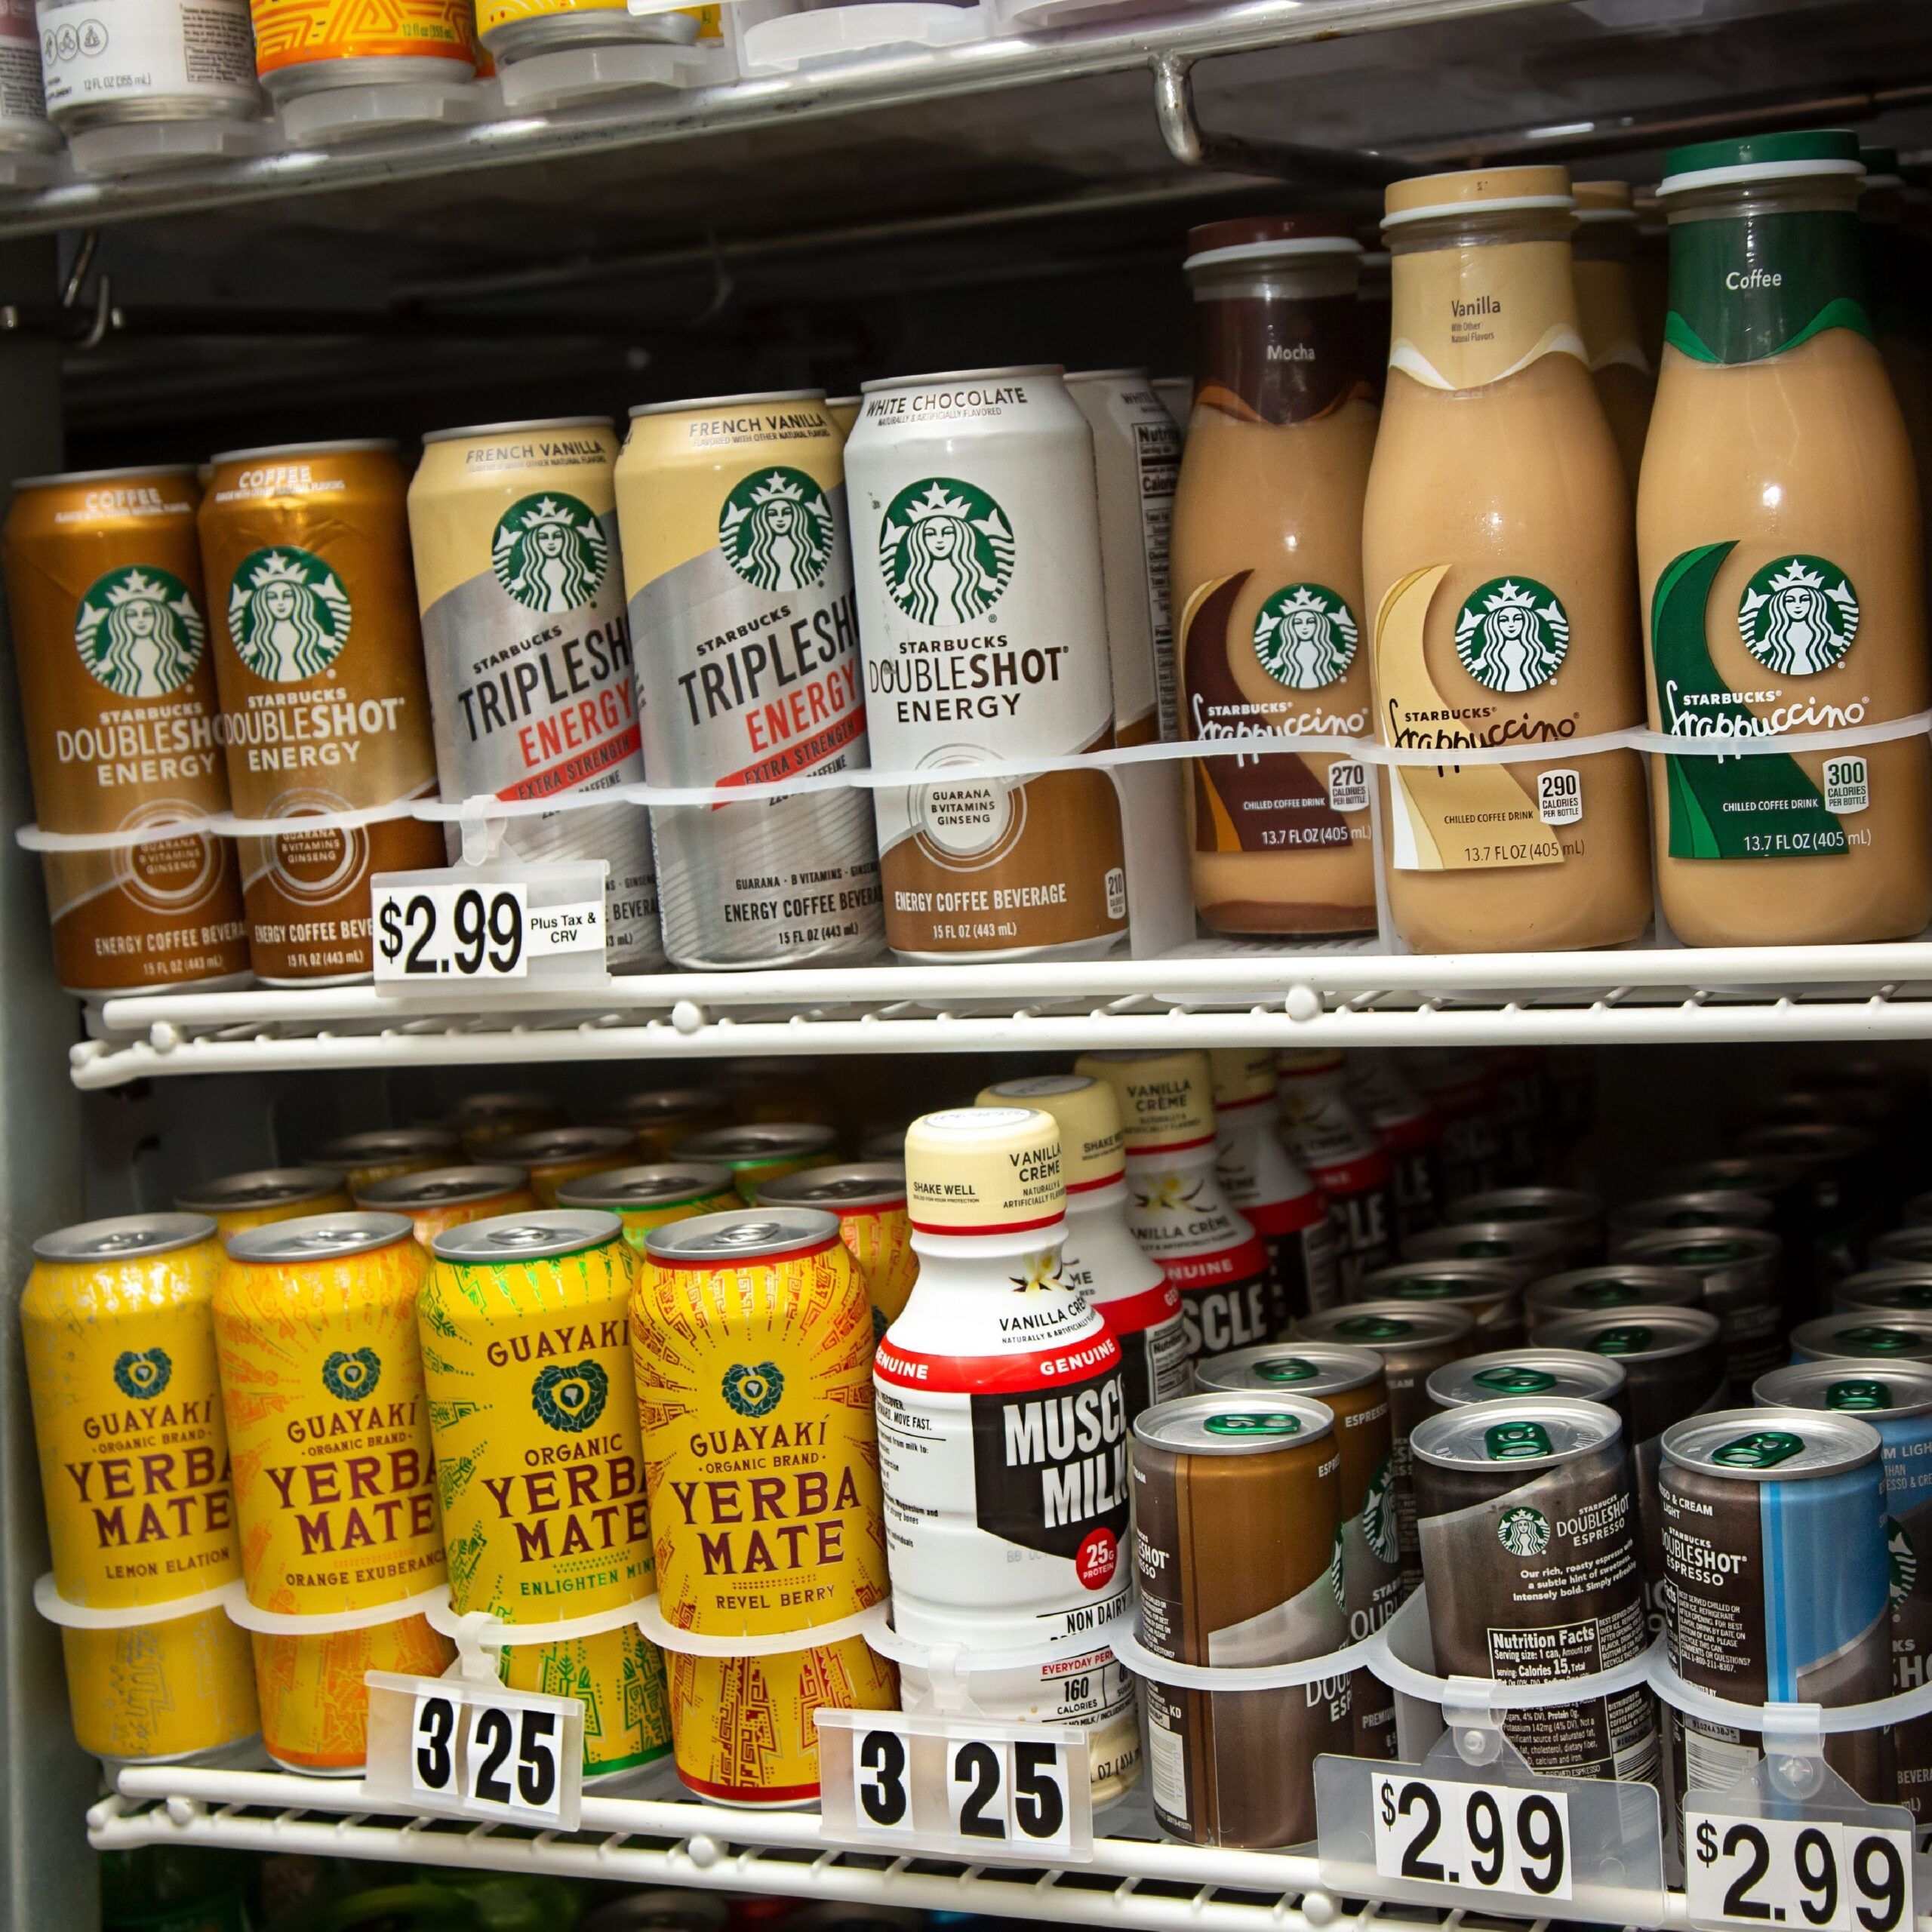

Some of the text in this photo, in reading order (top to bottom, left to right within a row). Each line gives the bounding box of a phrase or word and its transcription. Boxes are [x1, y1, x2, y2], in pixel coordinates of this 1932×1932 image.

[1726, 269, 1782, 291] Coffee
[1452, 296, 1500, 317] Vanilla
[1463, 321, 1480, 331] Other
[1472, 331, 1494, 341] Flavors
[1266, 343, 1315, 361] Mocha
[866, 387, 1027, 417] WHITE CHOCOLATE
[690, 413, 827, 437] FRENCH VANILLA
[915, 406, 1001, 422] ARTIFICIALLY FLAVORED
[465, 440, 603, 464] FRENCH VANILLA
[238, 465, 312, 488] COFFEE
[85, 488, 162, 509] COFFEE
[697, 605, 791, 657] STARBUCKS
[473, 626, 562, 674] STARBUCKS
[899, 635, 1008, 654] STARBUCKS
[678, 589, 862, 726] TRIPLESH
[457, 614, 633, 742] TRIPLESH
[869, 646, 1063, 694] DOUBLESHOT
[248, 688, 346, 708] STARBUCKS
[746, 660, 857, 752] ENERGY
[897, 693, 1021, 723] ENERGY
[1683, 691, 1776, 706] STARBUCKS
[100, 703, 202, 724] STARBUCKS
[1208, 703, 1287, 716] STARBUCKS
[1404, 707, 1492, 722] STARBUCKS
[225, 698, 398, 745] DOUBLESHOT
[517, 677, 633, 768] ENERGY
[57, 714, 225, 761] DOUBLESHO
[794, 720, 855, 763] STRENGTH
[248, 741, 360, 771] ENERGY
[98, 753, 217, 786] ENERGY
[518, 736, 630, 801] EXTRA STRENGTH
[1332, 765, 1364, 786] 270
[1829, 761, 1864, 786] 300
[932, 789, 991, 801] GUARANA
[1333, 787, 1366, 798] CALORIES
[1543, 775, 1577, 798] 290
[1828, 786, 1866, 798] CALORIES
[940, 801, 995, 812] VITAMINS
[1543, 798, 1578, 810] CALORIES
[1723, 798, 1818, 812] CHILLED COFFEE DRINK
[1829, 795, 1866, 807] PER BOTTLE
[938, 814, 990, 825] GINSENG
[1444, 810, 1534, 824] CHILLED COFFEE DRINK
[1543, 808, 1578, 817] PER BOTTLE
[291, 838, 340, 852] VITAMINS
[1464, 839, 1584, 862] 13.7 FL OZ (405 mL)
[1743, 829, 1871, 851] 13.7 FL OZ (405 mL)
[288, 851, 336, 863] GINSENG
[736, 869, 842, 891] GUARANA VITAMINS
[724, 894, 835, 923] ENERGY COFFEE
[895, 884, 1066, 912] ENERGY COFFEE BEVERAGE
[255, 920, 336, 943] ENERGY COFFEE
[379, 888, 522, 975] $2.99
[531, 912, 583, 930] Plus Tax
[973, 922, 1017, 939] (443 mL)
[95, 929, 198, 956] ENERGY COFFEE
[550, 929, 577, 945] CRV
[1127, 1080, 1192, 1099] VANILLA
[1010, 1143, 1061, 1167] VANILLA
[1019, 1158, 1060, 1183] CRÈME
[913, 1181, 975, 1195] SHAKE WELL
[1023, 1184, 1057, 1196] NATURALLY
[1003, 1195, 1048, 1208] ARTIFICIALLY
[999, 1309, 1066, 1331] VANILLA
[1002, 1333, 1045, 1344] NATURALLY
[1040, 1338, 1115, 1376] GENUINE
[84, 1392, 215, 1441] GUAYAKÍ
[287, 1393, 421, 1444] GUAYAKÍ
[912, 1417, 932, 1431] FAST.
[1003, 1373, 1127, 1466] MUSC
[162, 1429, 205, 1445] BRAND
[307, 1432, 407, 1457] ORGANIC BRAND
[690, 1414, 831, 1458] GUAYAKÍ
[525, 1435, 623, 1466] ORGANIC
[706, 1453, 820, 1475] ORGANIC BRAND
[670, 1465, 862, 1527] YERBA
[1579, 1494, 1617, 1515] STARBUCKS
[92, 1488, 230, 1549] MATE
[1556, 1492, 1629, 1538] DOUBLESHOT
[1663, 1506, 1681, 1520] LIGHT
[1678, 1499, 1713, 1516] CREAM
[294, 1494, 435, 1555] MATE
[513, 1500, 650, 1563] MATE
[1573, 1518, 1625, 1547] ESPRESSO
[697, 1518, 846, 1577] MATE
[1669, 1527, 1712, 1549] STARBUCKS
[106, 1546, 230, 1580] LEMON ELATION
[1083, 1562, 1114, 1580] PROTEIN
[1521, 1549, 1623, 1580] Our rich, roasty espresso
[1666, 1554, 1724, 1586] ESPRESSO
[286, 1571, 349, 1587] ORANGE
[521, 1571, 619, 1597] ENLIGHTEN
[1513, 1577, 1611, 1602] Intensely bold. Simply
[1537, 1574, 1587, 1589] subtle hint
[716, 1584, 835, 1611] REVEL BERRY
[1707, 1599, 1730, 1612] CHILLED
[1066, 1596, 1127, 1634] NON DAIRY
[1493, 1626, 1595, 1650] Nutrition Facts
[1727, 1623, 1743, 1631] BEST
[1717, 1638, 1738, 1647] PLEASE
[1494, 1646, 1583, 1662] Serving size: Amount
[1714, 1653, 1751, 1666] QUESTIONS?
[1042, 1657, 1092, 1675] EVERYDAY
[1518, 1663, 1552, 1678] Calories
[1065, 1676, 1089, 1703] 160
[1057, 1700, 1098, 1715] CALORIES
[1548, 1710, 1568, 1720] Protein
[416, 1697, 557, 1806] 3 25
[861, 1730, 1066, 1841] 3 25
[1381, 1777, 1565, 1896] $2.99
[1697, 1820, 1906, 1931] $2.99
